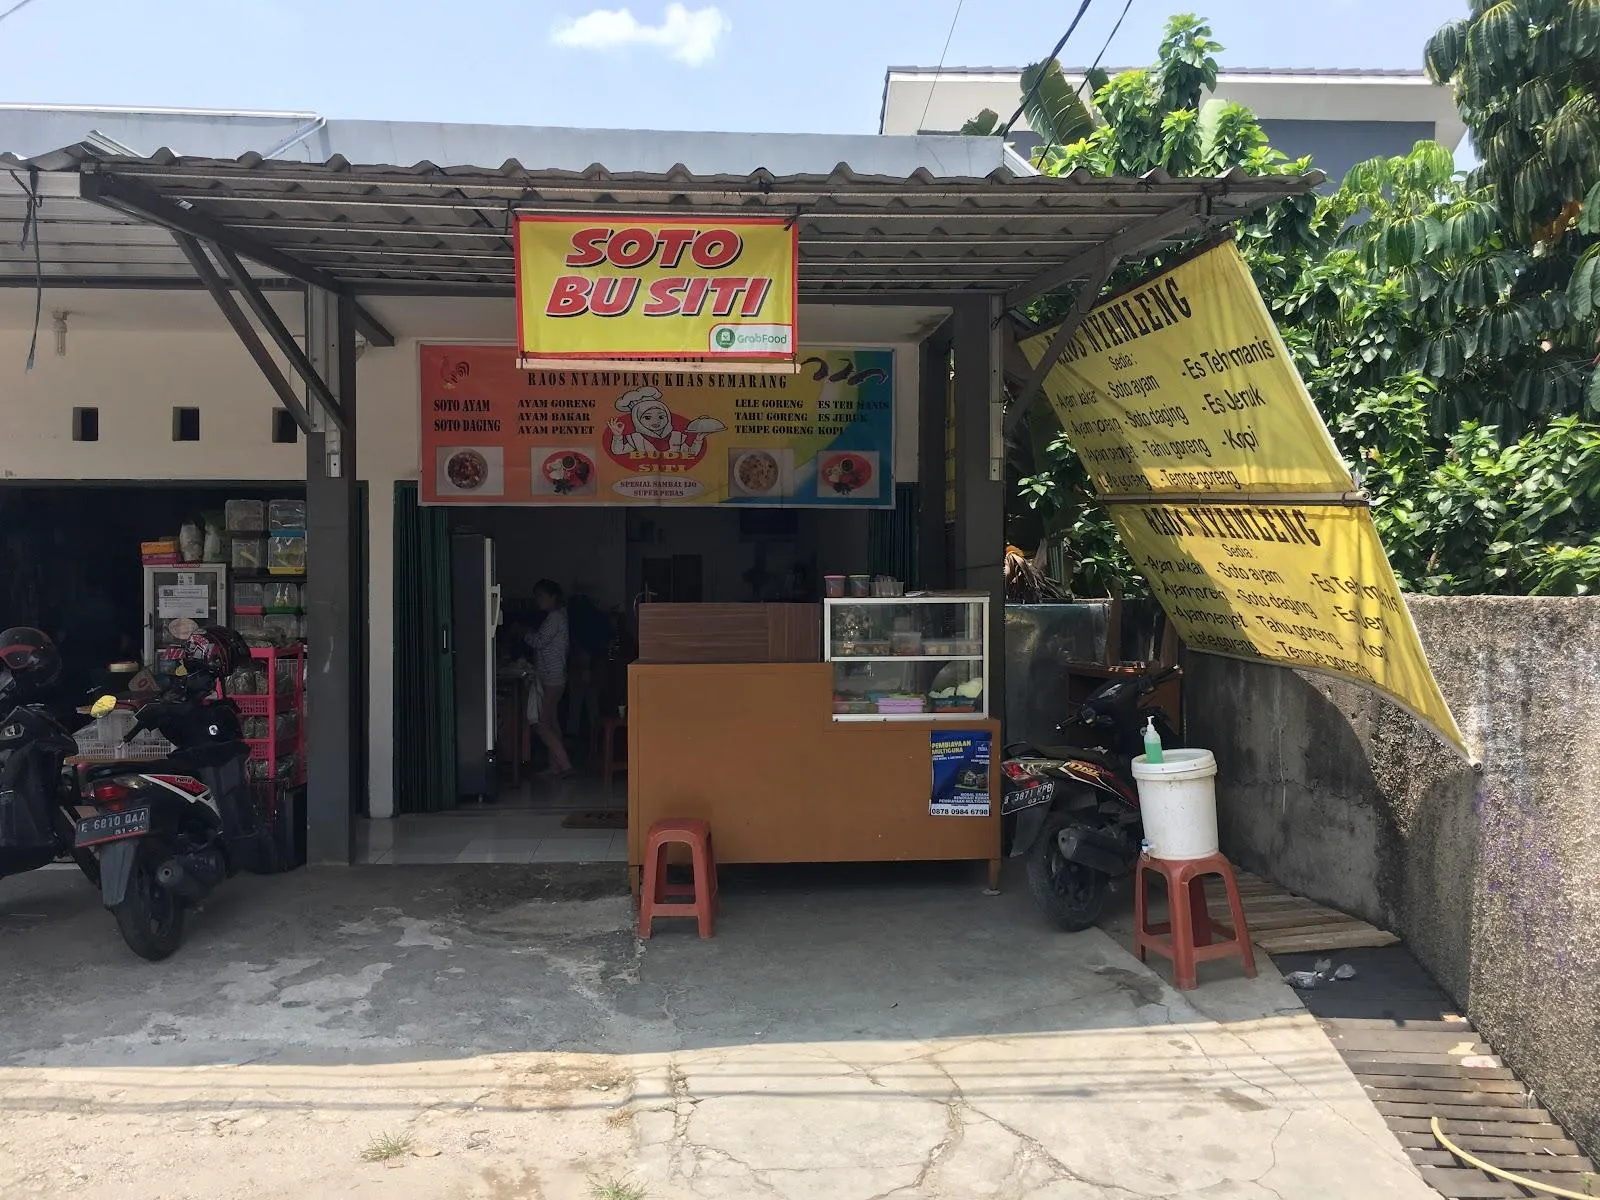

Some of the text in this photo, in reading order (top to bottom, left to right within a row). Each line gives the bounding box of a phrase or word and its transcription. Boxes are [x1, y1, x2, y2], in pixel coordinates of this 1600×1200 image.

[565, 228, 743, 269] SOTO
[545, 275, 772, 317] BU SITI
[1079, 277, 1193, 353] NYAMLENG
[737, 332, 787, 344] GrabFood
[528, 372, 787, 389] RAOS NYAMPLENG KHAS SEMARANG
[1132, 373, 1160, 398] ayam
[517, 399, 596, 409] AYAM GORENG
[735, 399, 804, 409] LELE GORENG
[818, 400, 830, 409] ES
[833, 400, 853, 409] TEH
[1226, 385, 1266, 411] Jeruk
[433, 399, 490, 412] SOTO AYAM
[517, 412, 590, 421] AYAM BAKAR
[735, 412, 808, 422] TAHU GORENG
[818, 413, 868, 423] ES JERUK
[1149, 403, 1190, 428] daging
[434, 419, 501, 432] SOTO DAGING
[517, 425, 595, 435] AYAM PENYET
[735, 425, 814, 435] TEMPE GORENG
[818, 426, 844, 435] KOPI
[1169, 435, 1212, 460] goreng
[628, 450, 696, 460] BUDE
[638, 464, 687, 473] SITI
[620, 480, 652, 488] SPESIAL
[653, 480, 682, 488] SAMBAL
[1198, 468, 1241, 490] goreng
[1141, 508, 1321, 547] RAOS NYAMLENG
[1251, 565, 1284, 588] ayam
[1268, 591, 1318, 620] daging
[1291, 624, 1344, 651] goreng
[1325, 654, 1377, 684] goreng
[931, 747, 963, 755] MULTIGUNA
